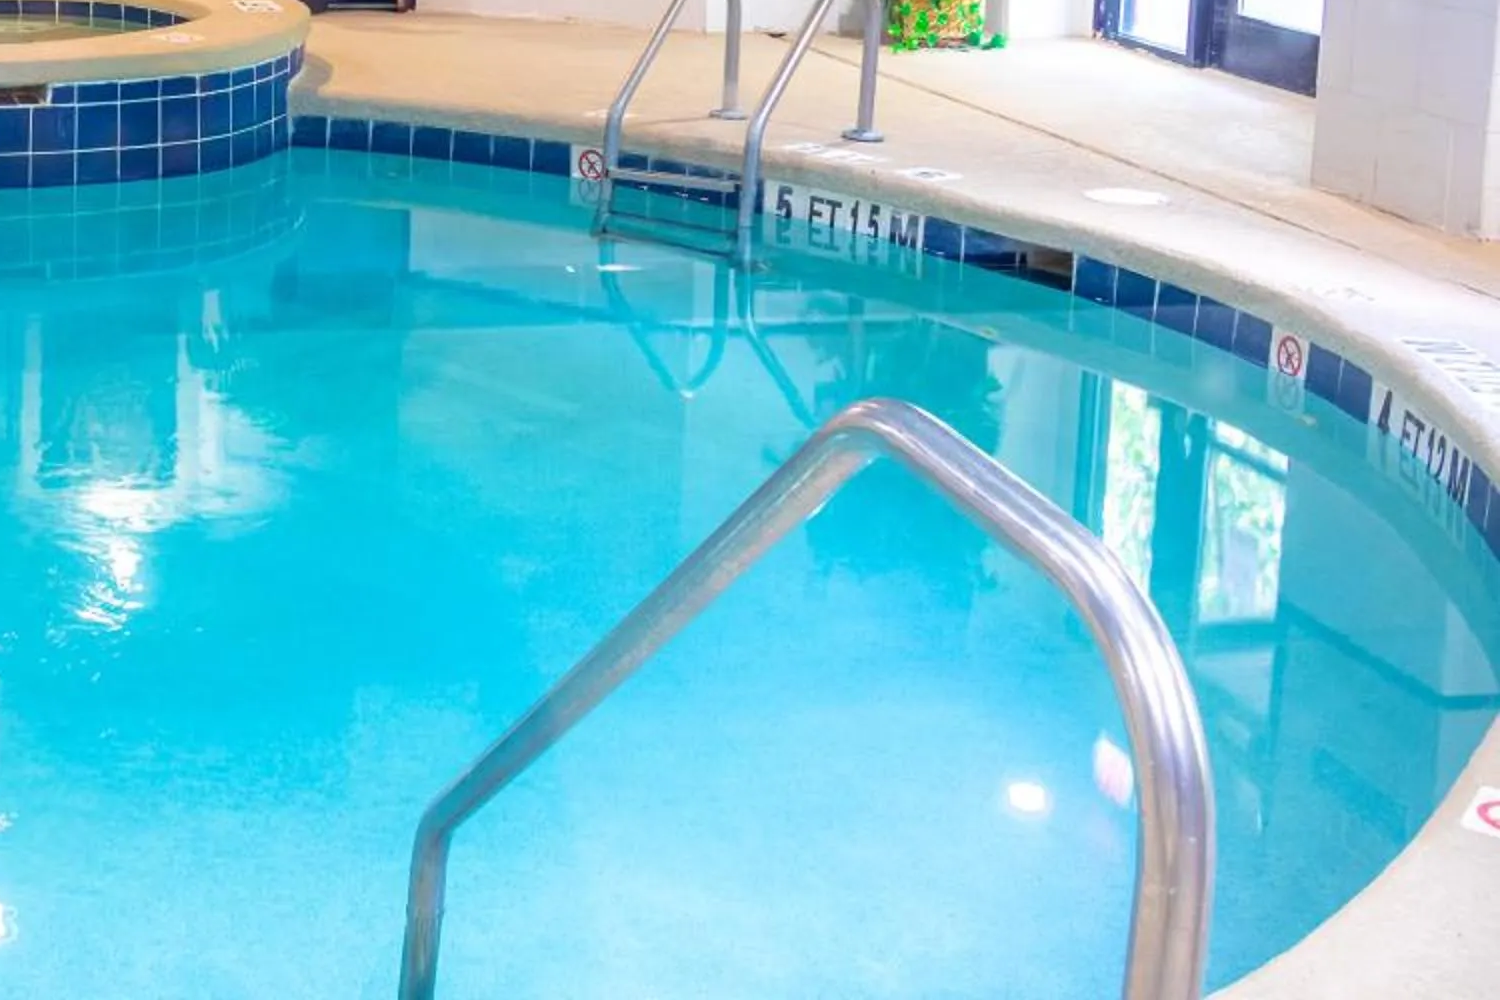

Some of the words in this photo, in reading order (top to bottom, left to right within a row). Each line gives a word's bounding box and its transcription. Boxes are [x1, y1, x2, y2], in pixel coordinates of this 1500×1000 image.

[775, 185, 793, 219] 5
[808, 195, 842, 228] FT
[889, 209, 920, 249] M
[1377, 389, 1393, 435] 4
[1399, 409, 1425, 458] FT
[1447, 445, 1471, 509] M
